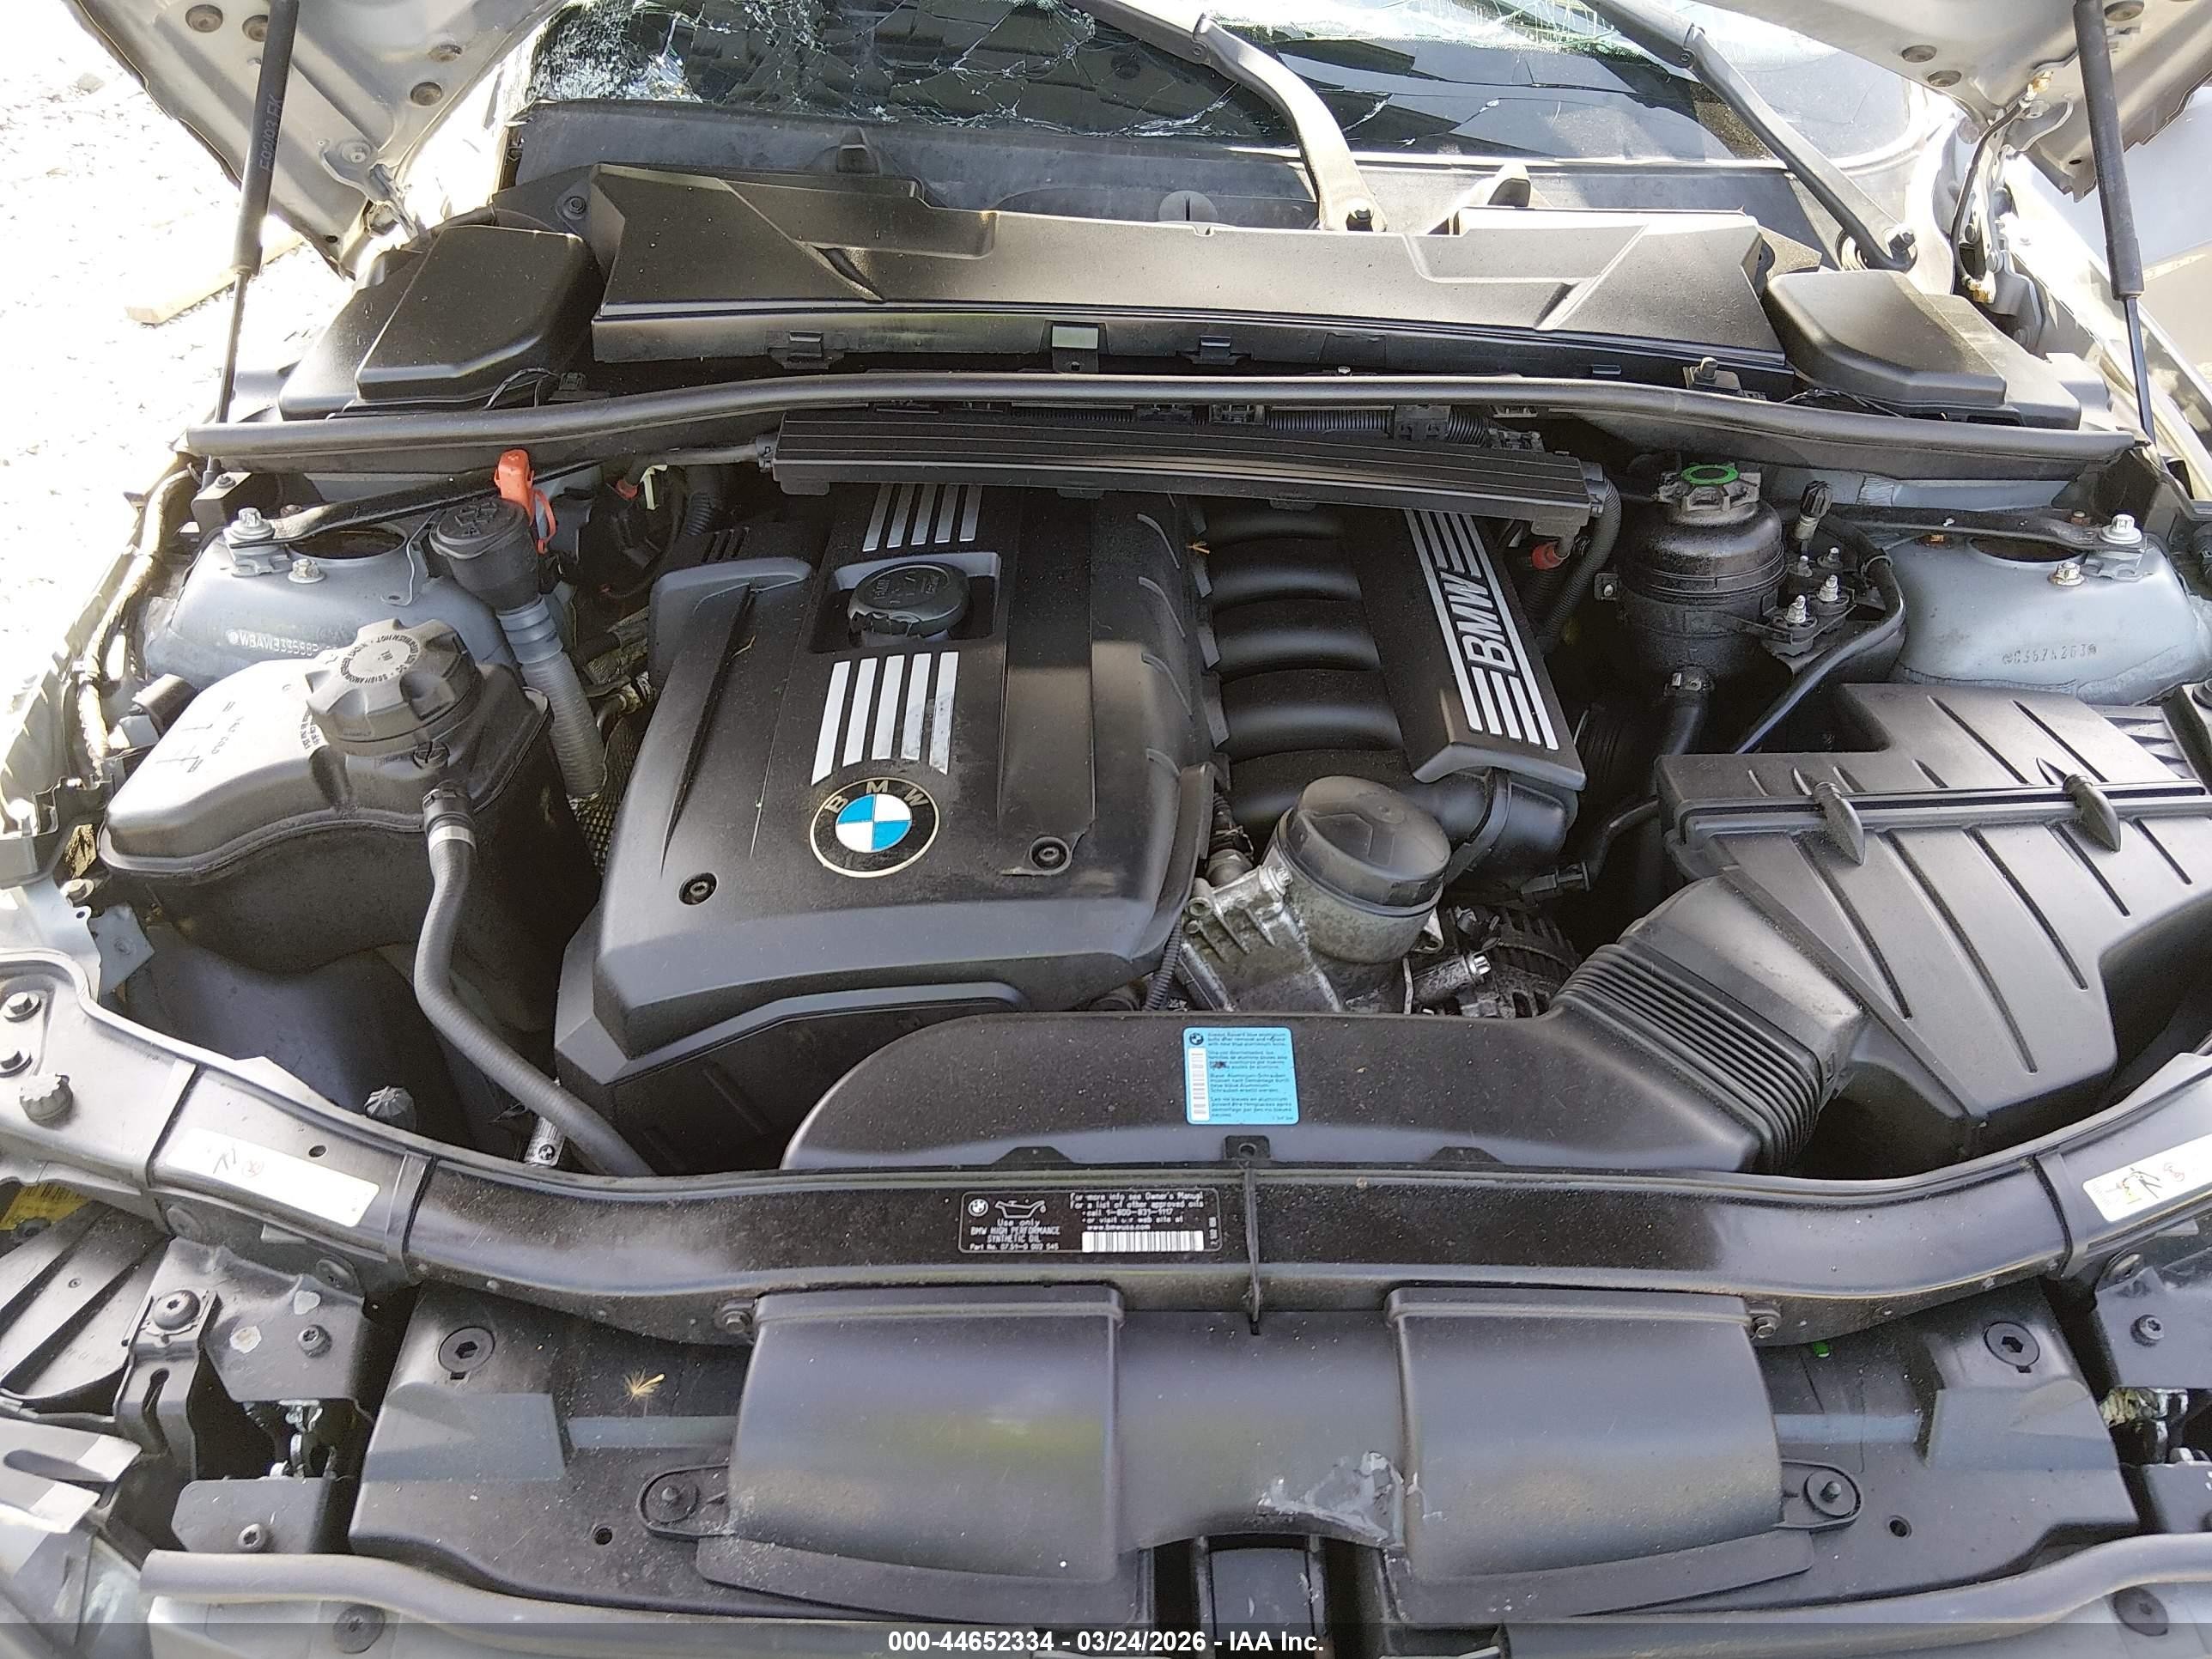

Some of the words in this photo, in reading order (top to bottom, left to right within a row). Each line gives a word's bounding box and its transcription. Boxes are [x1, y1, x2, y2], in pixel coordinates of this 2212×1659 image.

[1440, 571, 1516, 672] BMW
[824, 780, 929, 814] BMW
[1018, 1218, 1041, 1227] only
[970, 1226, 988, 1236] BMW
[990, 1226, 1008, 1235] HIGH
[1010, 1225, 1061, 1235] PERFORMANCE
[987, 1235, 1027, 1243] SYNTHETIC
[1029, 1234, 1042, 1243] OIL
